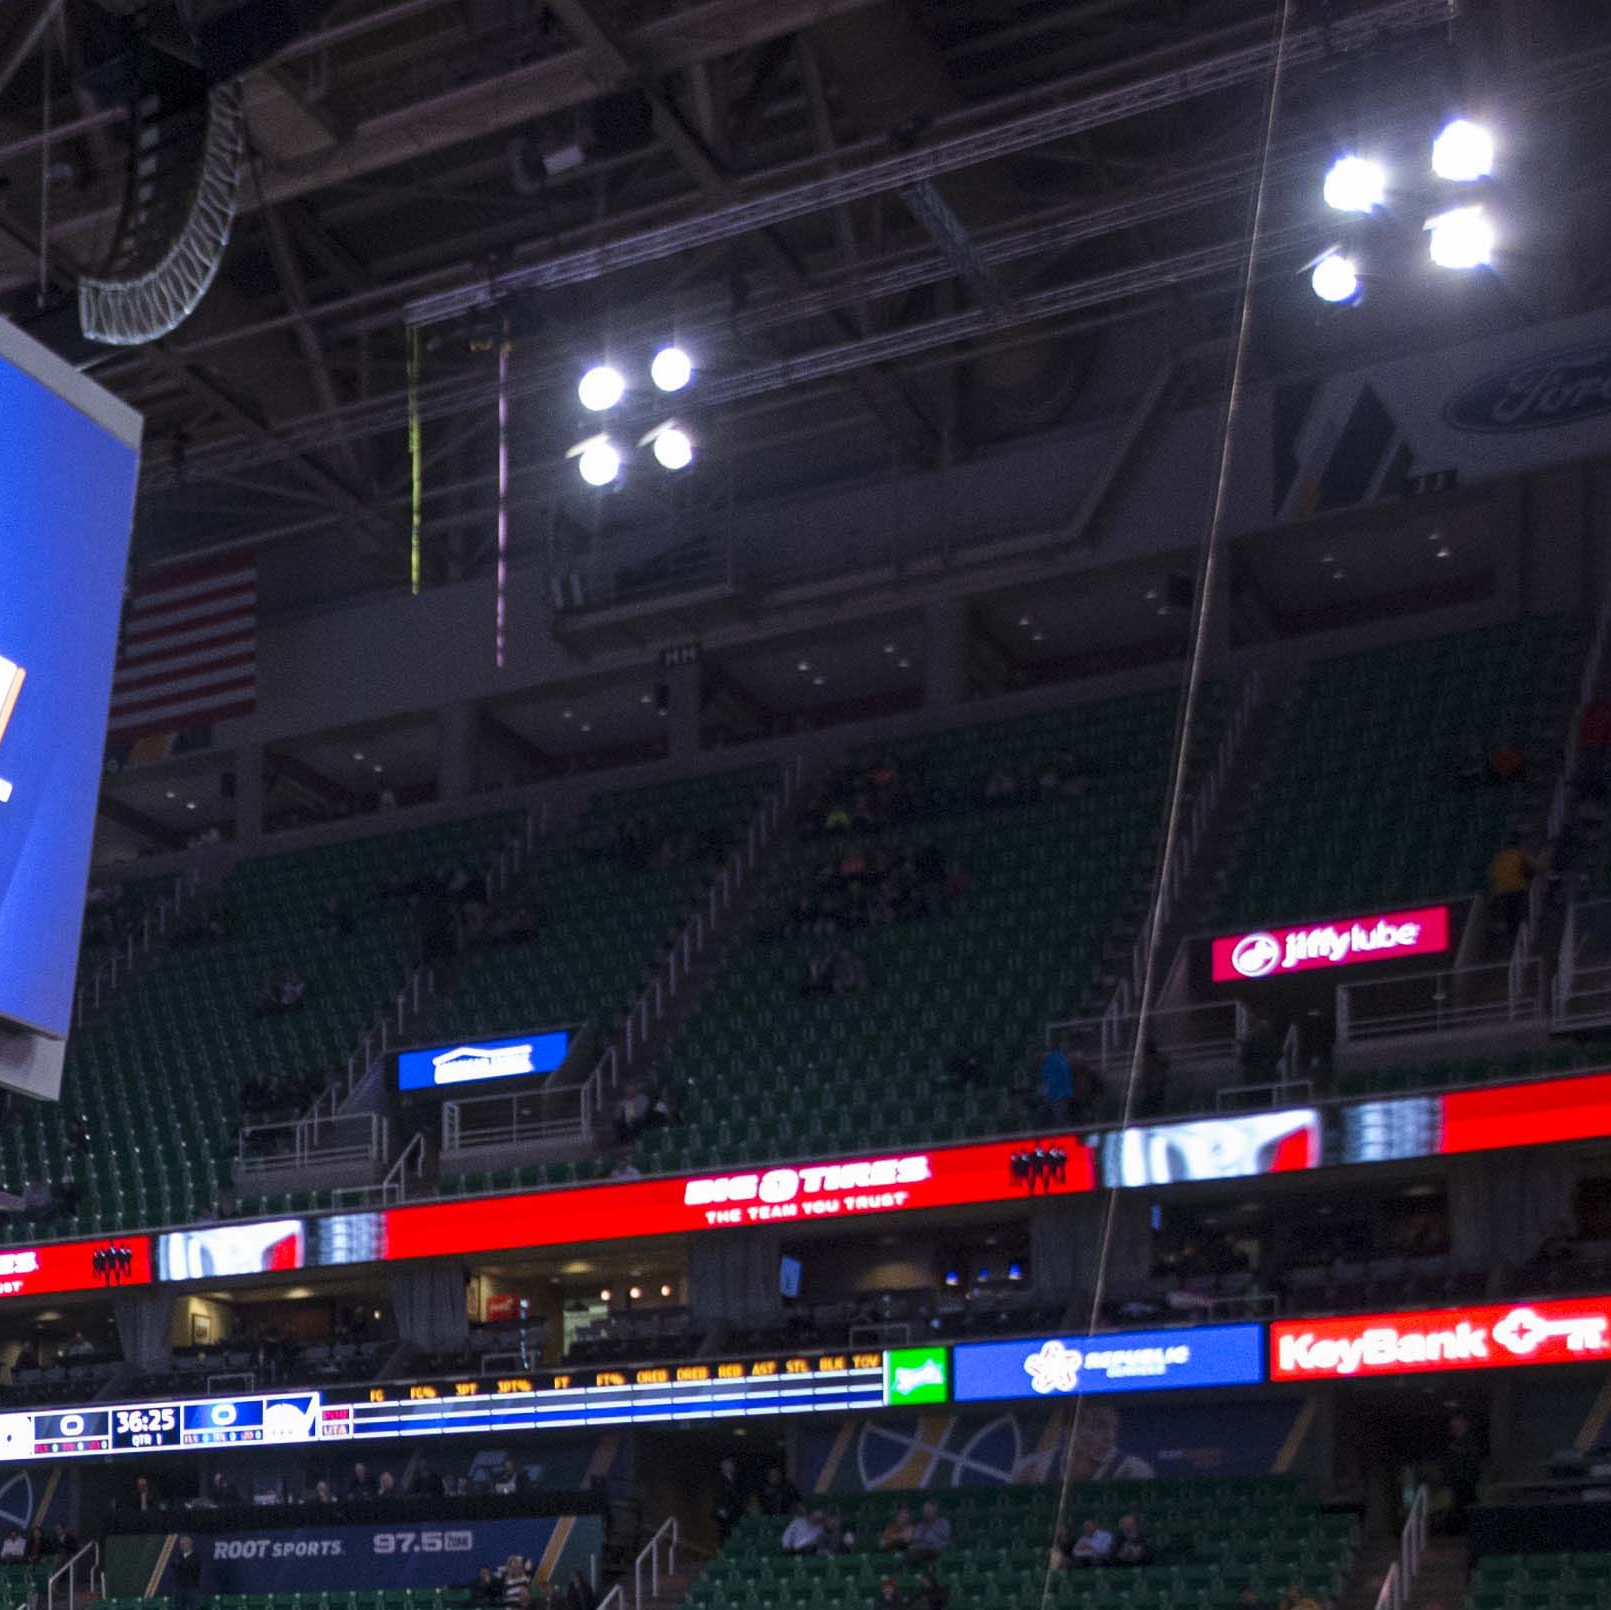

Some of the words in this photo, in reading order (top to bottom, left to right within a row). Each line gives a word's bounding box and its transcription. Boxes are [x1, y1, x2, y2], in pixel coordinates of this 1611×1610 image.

[684, 1173, 759, 1206] BIG
[798, 1155, 931, 1193] TIRES
[705, 1209, 742, 1226] THE
[746, 1203, 798, 1221] TEAM
[801, 1197, 841, 1217] YOU
[842, 1190, 910, 1211] TRUST
[1278, 1319, 1489, 1374] KeyBank
[751, 1359, 778, 1377] AST
[785, 1356, 811, 1374] STL
[818, 1354, 847, 1373] BLK
[852, 1352, 882, 1370] TOV
[636, 1367, 670, 1384] OREB
[717, 1362, 745, 1379] REB
[454, 1381, 480, 1396] 3PT
[496, 1378, 534, 1394] 3PT%
[553, 1375, 572, 1390] FT
[369, 1387, 386, 1403] FG
[409, 1384, 438, 1401] FG%
[115, 1407, 176, 1435] 36:25
[210, 1403, 238, 1427] 0
[58, 1414, 85, 1437] 0
[131, 1432, 154, 1449] QTR
[213, 1539, 271, 1561] ROOT
[272, 1538, 343, 1559] SPORTS
[372, 1531, 444, 1554] 97.5
